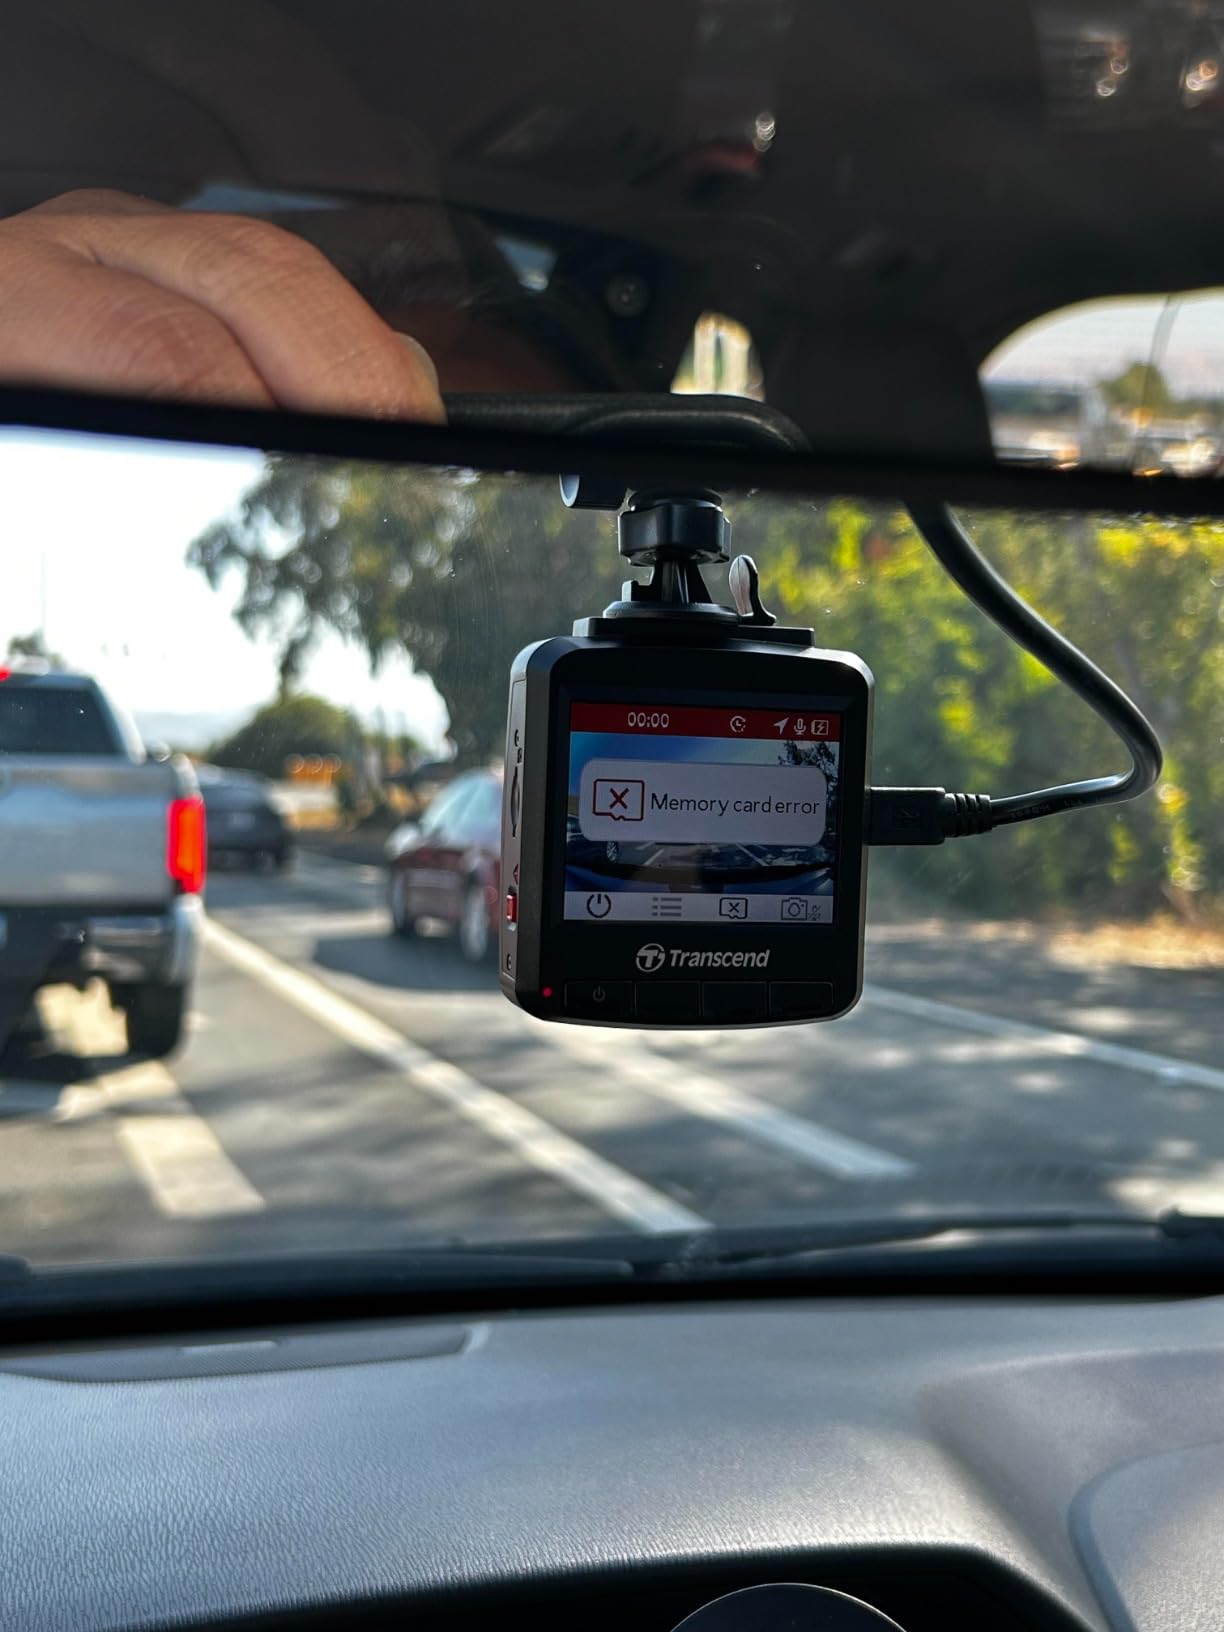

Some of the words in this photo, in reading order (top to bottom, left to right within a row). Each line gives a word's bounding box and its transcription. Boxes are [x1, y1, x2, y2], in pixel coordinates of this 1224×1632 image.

[627, 711, 670, 729] 00:00
[650, 793, 729, 816] Memory
[733, 796, 772, 813] card
[775, 800, 820, 815] error
[669, 949, 770, 968] Transcend
